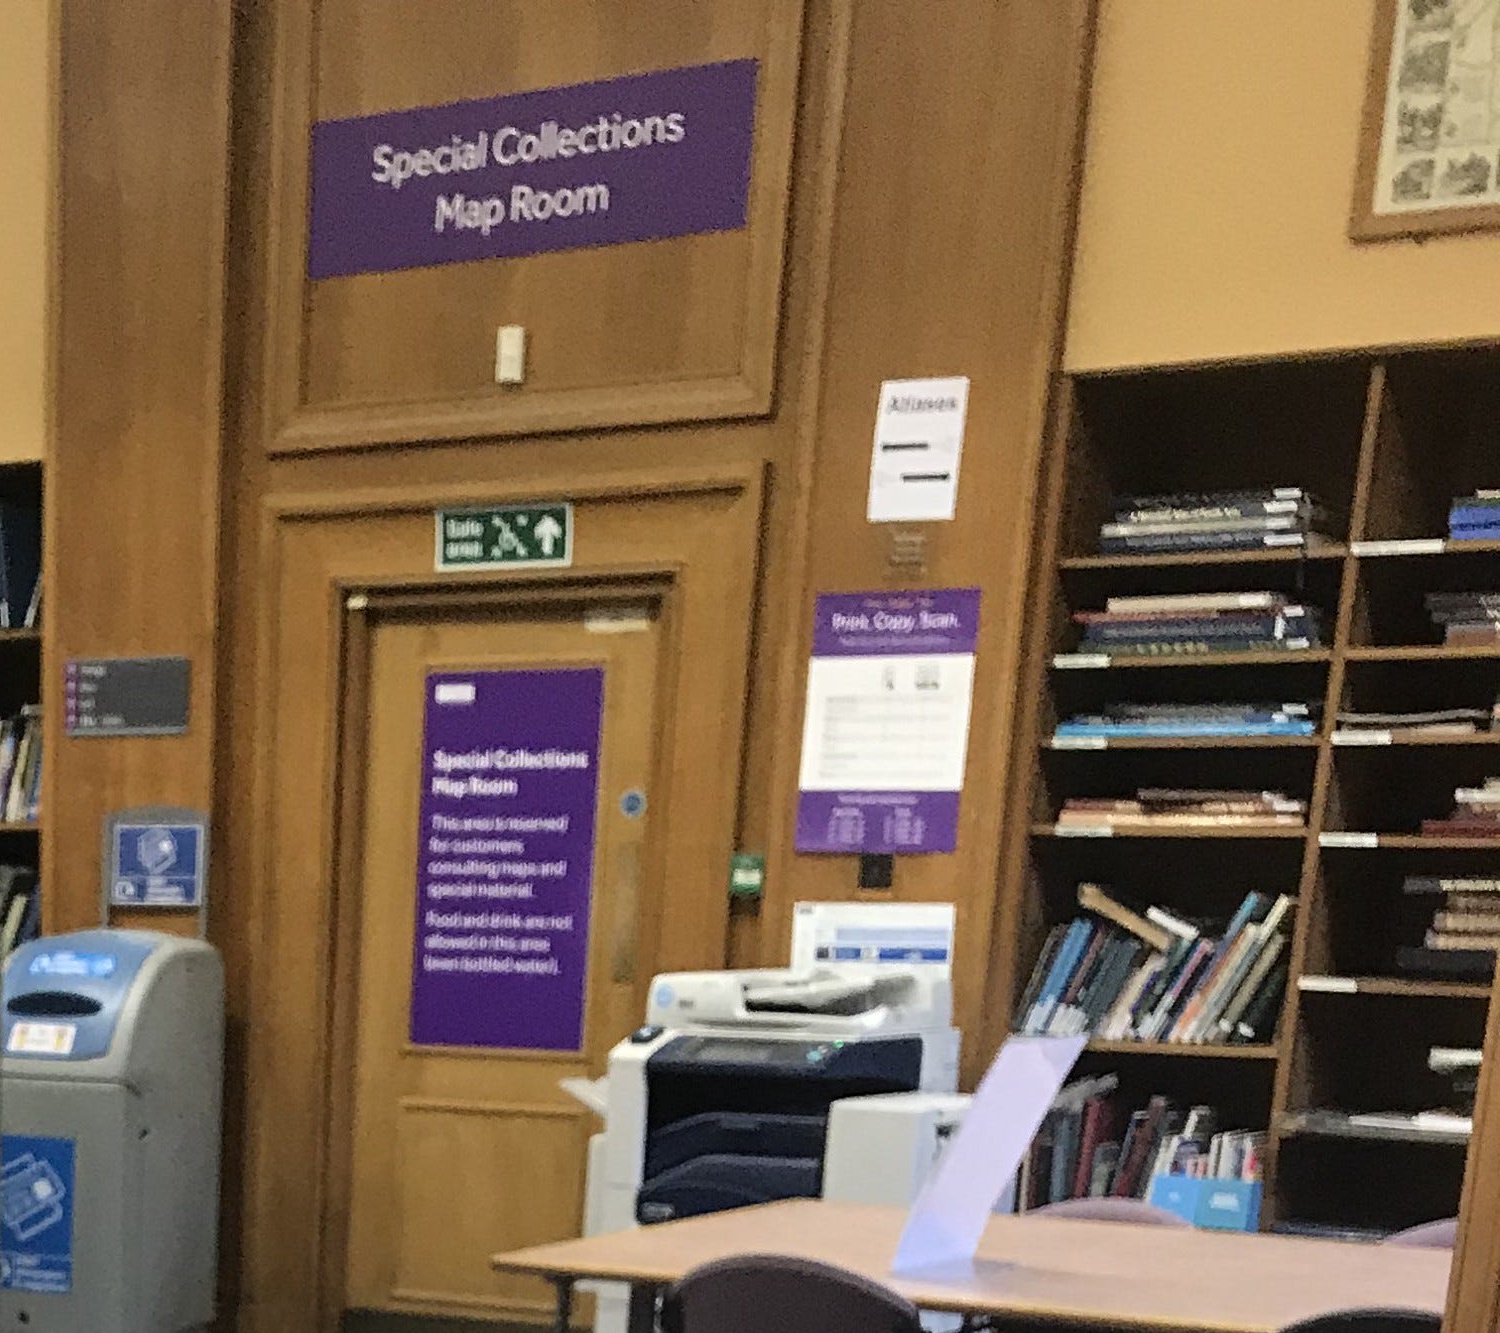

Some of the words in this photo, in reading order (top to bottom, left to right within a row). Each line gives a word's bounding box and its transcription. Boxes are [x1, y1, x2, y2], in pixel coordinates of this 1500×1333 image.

[371, 130, 488, 188] Special
[492, 111, 686, 167] Collections
[434, 193, 504, 236] Map
[510, 182, 610, 223] Room
[432, 748, 489, 772] Special
[491, 747, 589, 769] Collections
[432, 776, 467, 798] Map
[468, 776, 519, 796] Room
